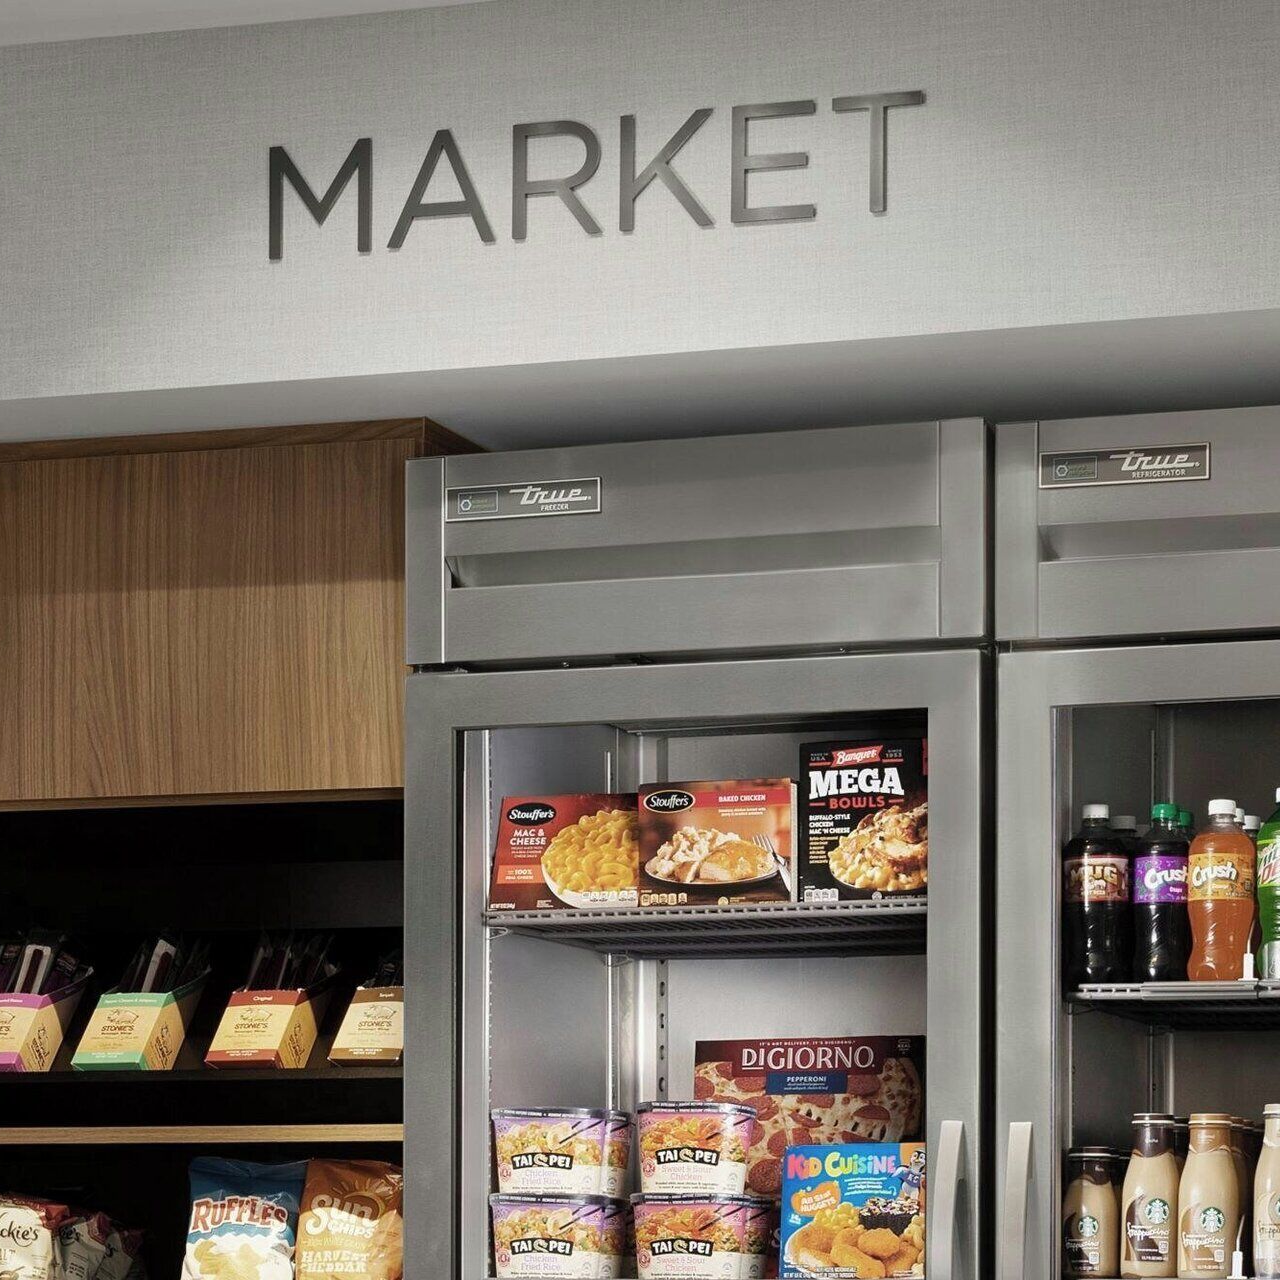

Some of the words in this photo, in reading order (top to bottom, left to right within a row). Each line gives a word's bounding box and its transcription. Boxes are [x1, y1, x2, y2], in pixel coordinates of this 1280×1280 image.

[269, 90, 925, 261] MARKET
[1132, 469, 1185, 478] REFRIGERATOR
[836, 749, 877, 764] Banquet
[809, 767, 904, 799] MEGA
[650, 795, 688, 808] Stouffer's
[830, 796, 885, 809] BOWLS
[509, 809, 554, 820] Stouffer's
[1192, 861, 1238, 887] Crush
[513, 1155, 532, 1167] TAI
[548, 1154, 570, 1167] PEI
[658, 1151, 678, 1163] TAI
[694, 1150, 717, 1164] PEI
[525, 1169, 557, 1177] Chicken
[661, 1165, 685, 1173] Sweet
[670, 1173, 702, 1181] Chicken
[190, 1195, 288, 1234] RUFFLES
[512, 1241, 532, 1253] TAI
[548, 1241, 570, 1253] PEI
[652, 1242, 671, 1254] TAI
[688, 1242, 710, 1254] PEI
[301, 1251, 370, 1263] HARVEST
[524, 1255, 557, 1263] Chicken
[656, 1256, 680, 1264] Sweet
[302, 1263, 366, 1273] CHEDDAR
[521, 1263, 541, 1271] Fried
